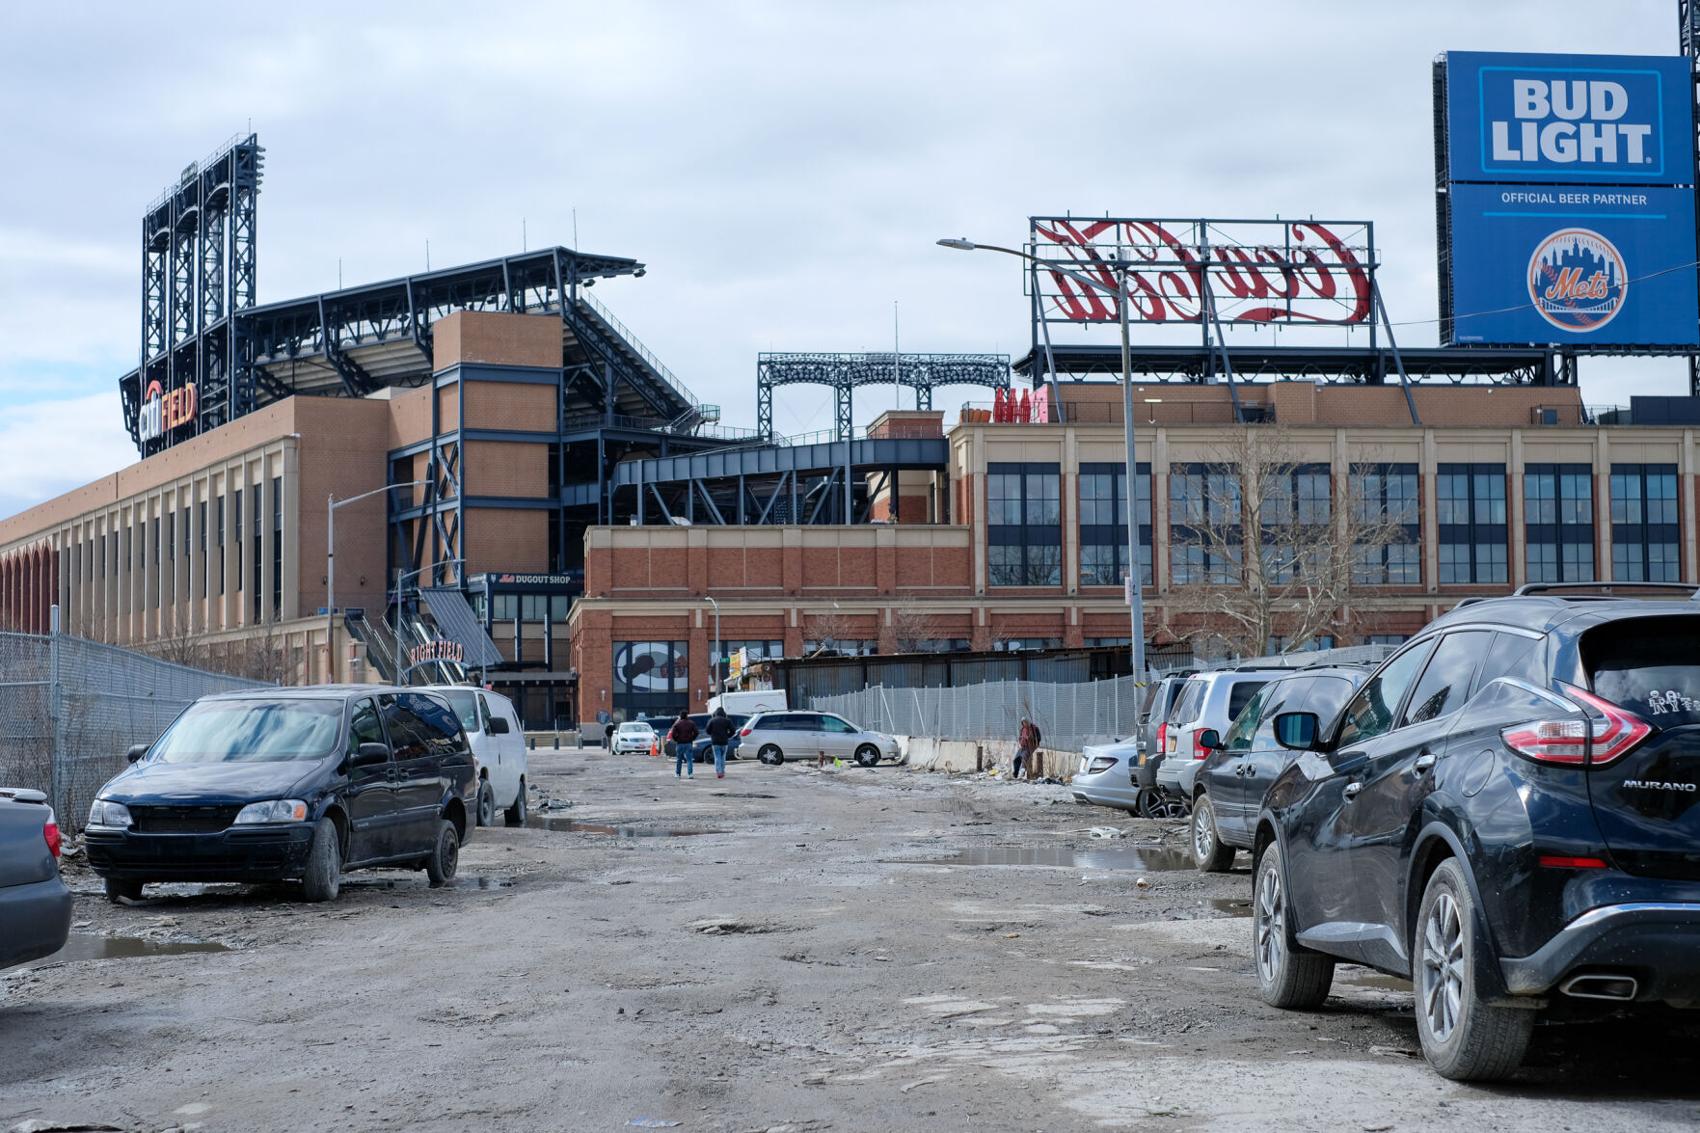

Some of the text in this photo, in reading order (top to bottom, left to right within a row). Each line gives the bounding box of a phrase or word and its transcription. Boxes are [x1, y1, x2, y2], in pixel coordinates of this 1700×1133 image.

[1513, 79, 1629, 120] BUD
[1501, 192, 1647, 205] OFFICIAL BEER PARTNER
[1545, 266, 1609, 300] Mets
[162, 382, 197, 433] FIELD
[516, 575, 549, 584] DUGOUT
[549, 576, 571, 584] SHOP
[410, 640, 463, 667] RIGHT FIELD
[1623, 780, 1697, 792] MURANO
